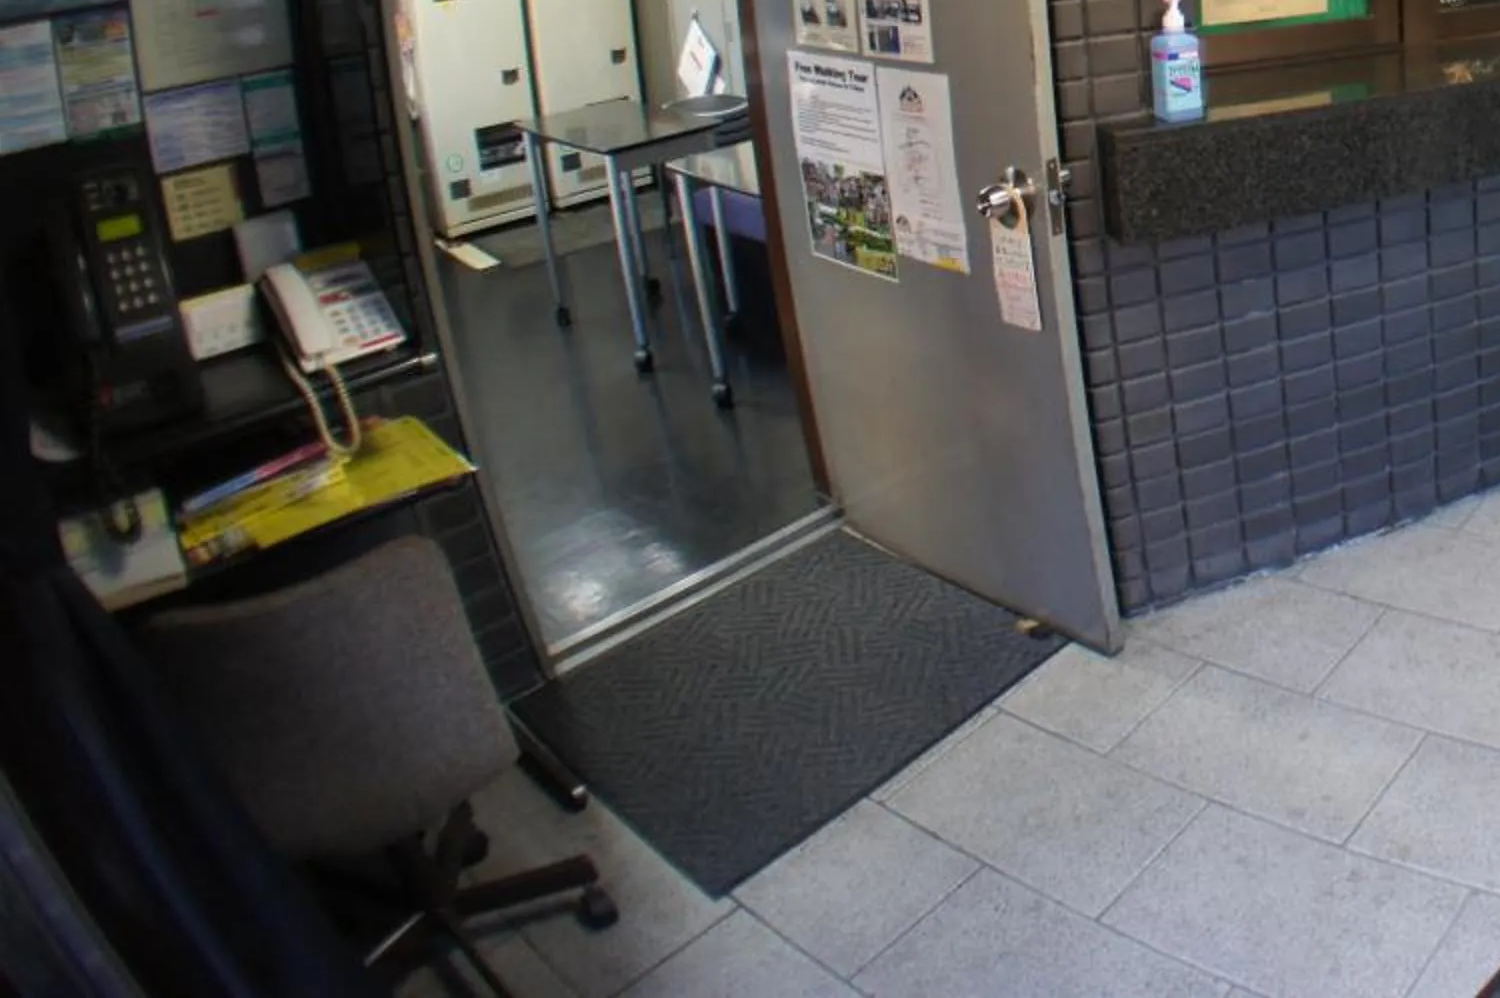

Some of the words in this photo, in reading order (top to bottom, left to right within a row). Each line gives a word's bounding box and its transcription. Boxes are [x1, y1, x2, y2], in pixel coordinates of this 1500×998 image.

[795, 61, 812, 74] Free
[814, 64, 846, 82] Walking
[848, 69, 869, 83] Tour
